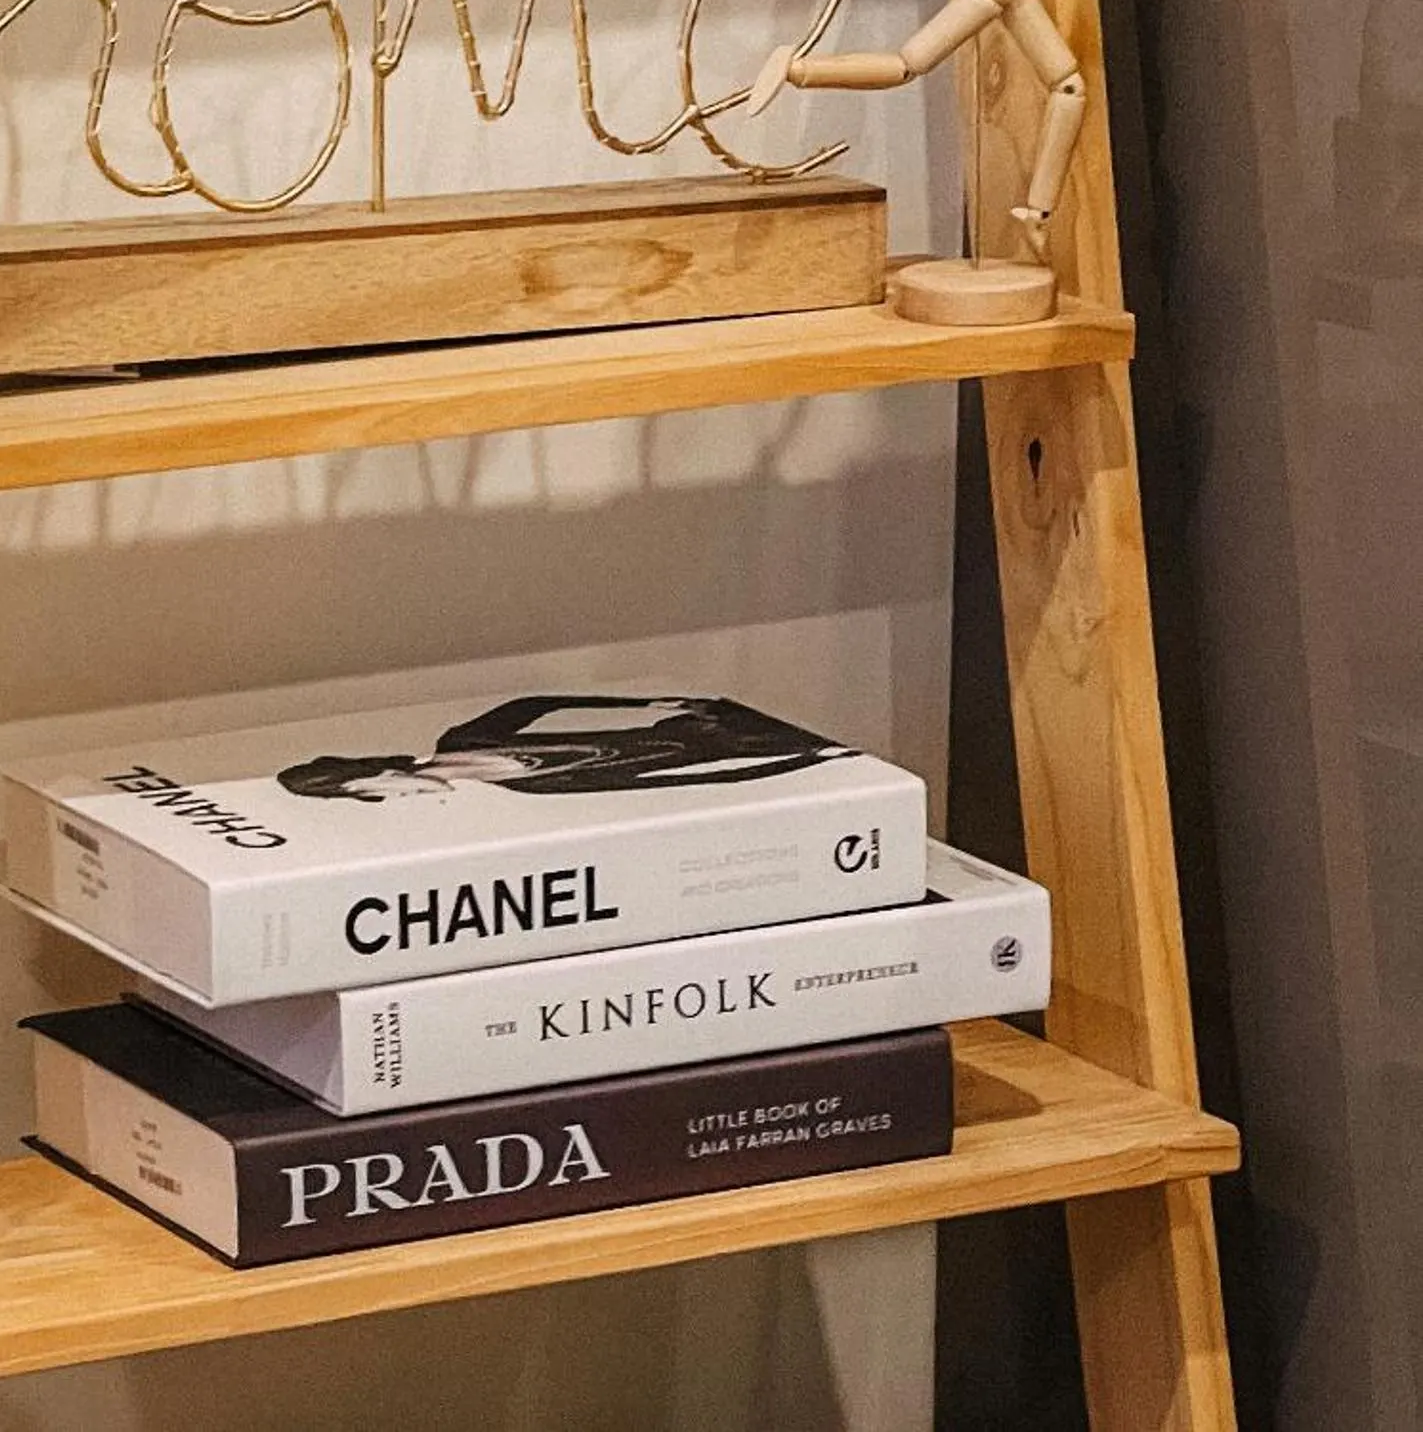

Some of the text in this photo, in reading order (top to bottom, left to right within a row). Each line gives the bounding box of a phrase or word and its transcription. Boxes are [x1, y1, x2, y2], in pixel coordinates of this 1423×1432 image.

[102, 765, 288, 849] CHANEL
[344, 865, 620, 956] CHANEL
[387, 1001, 403, 1089] WILLIAMS
[485, 1020, 518, 1038] THE
[539, 971, 777, 1042] KINFOLK
[372, 1012, 386, 1084] NATHAN
[687, 1096, 843, 1134] LITTLE BOOK OF
[687, 1113, 893, 1159] LAIA FARRAN GRAVES
[280, 1123, 612, 1230] PRADA
